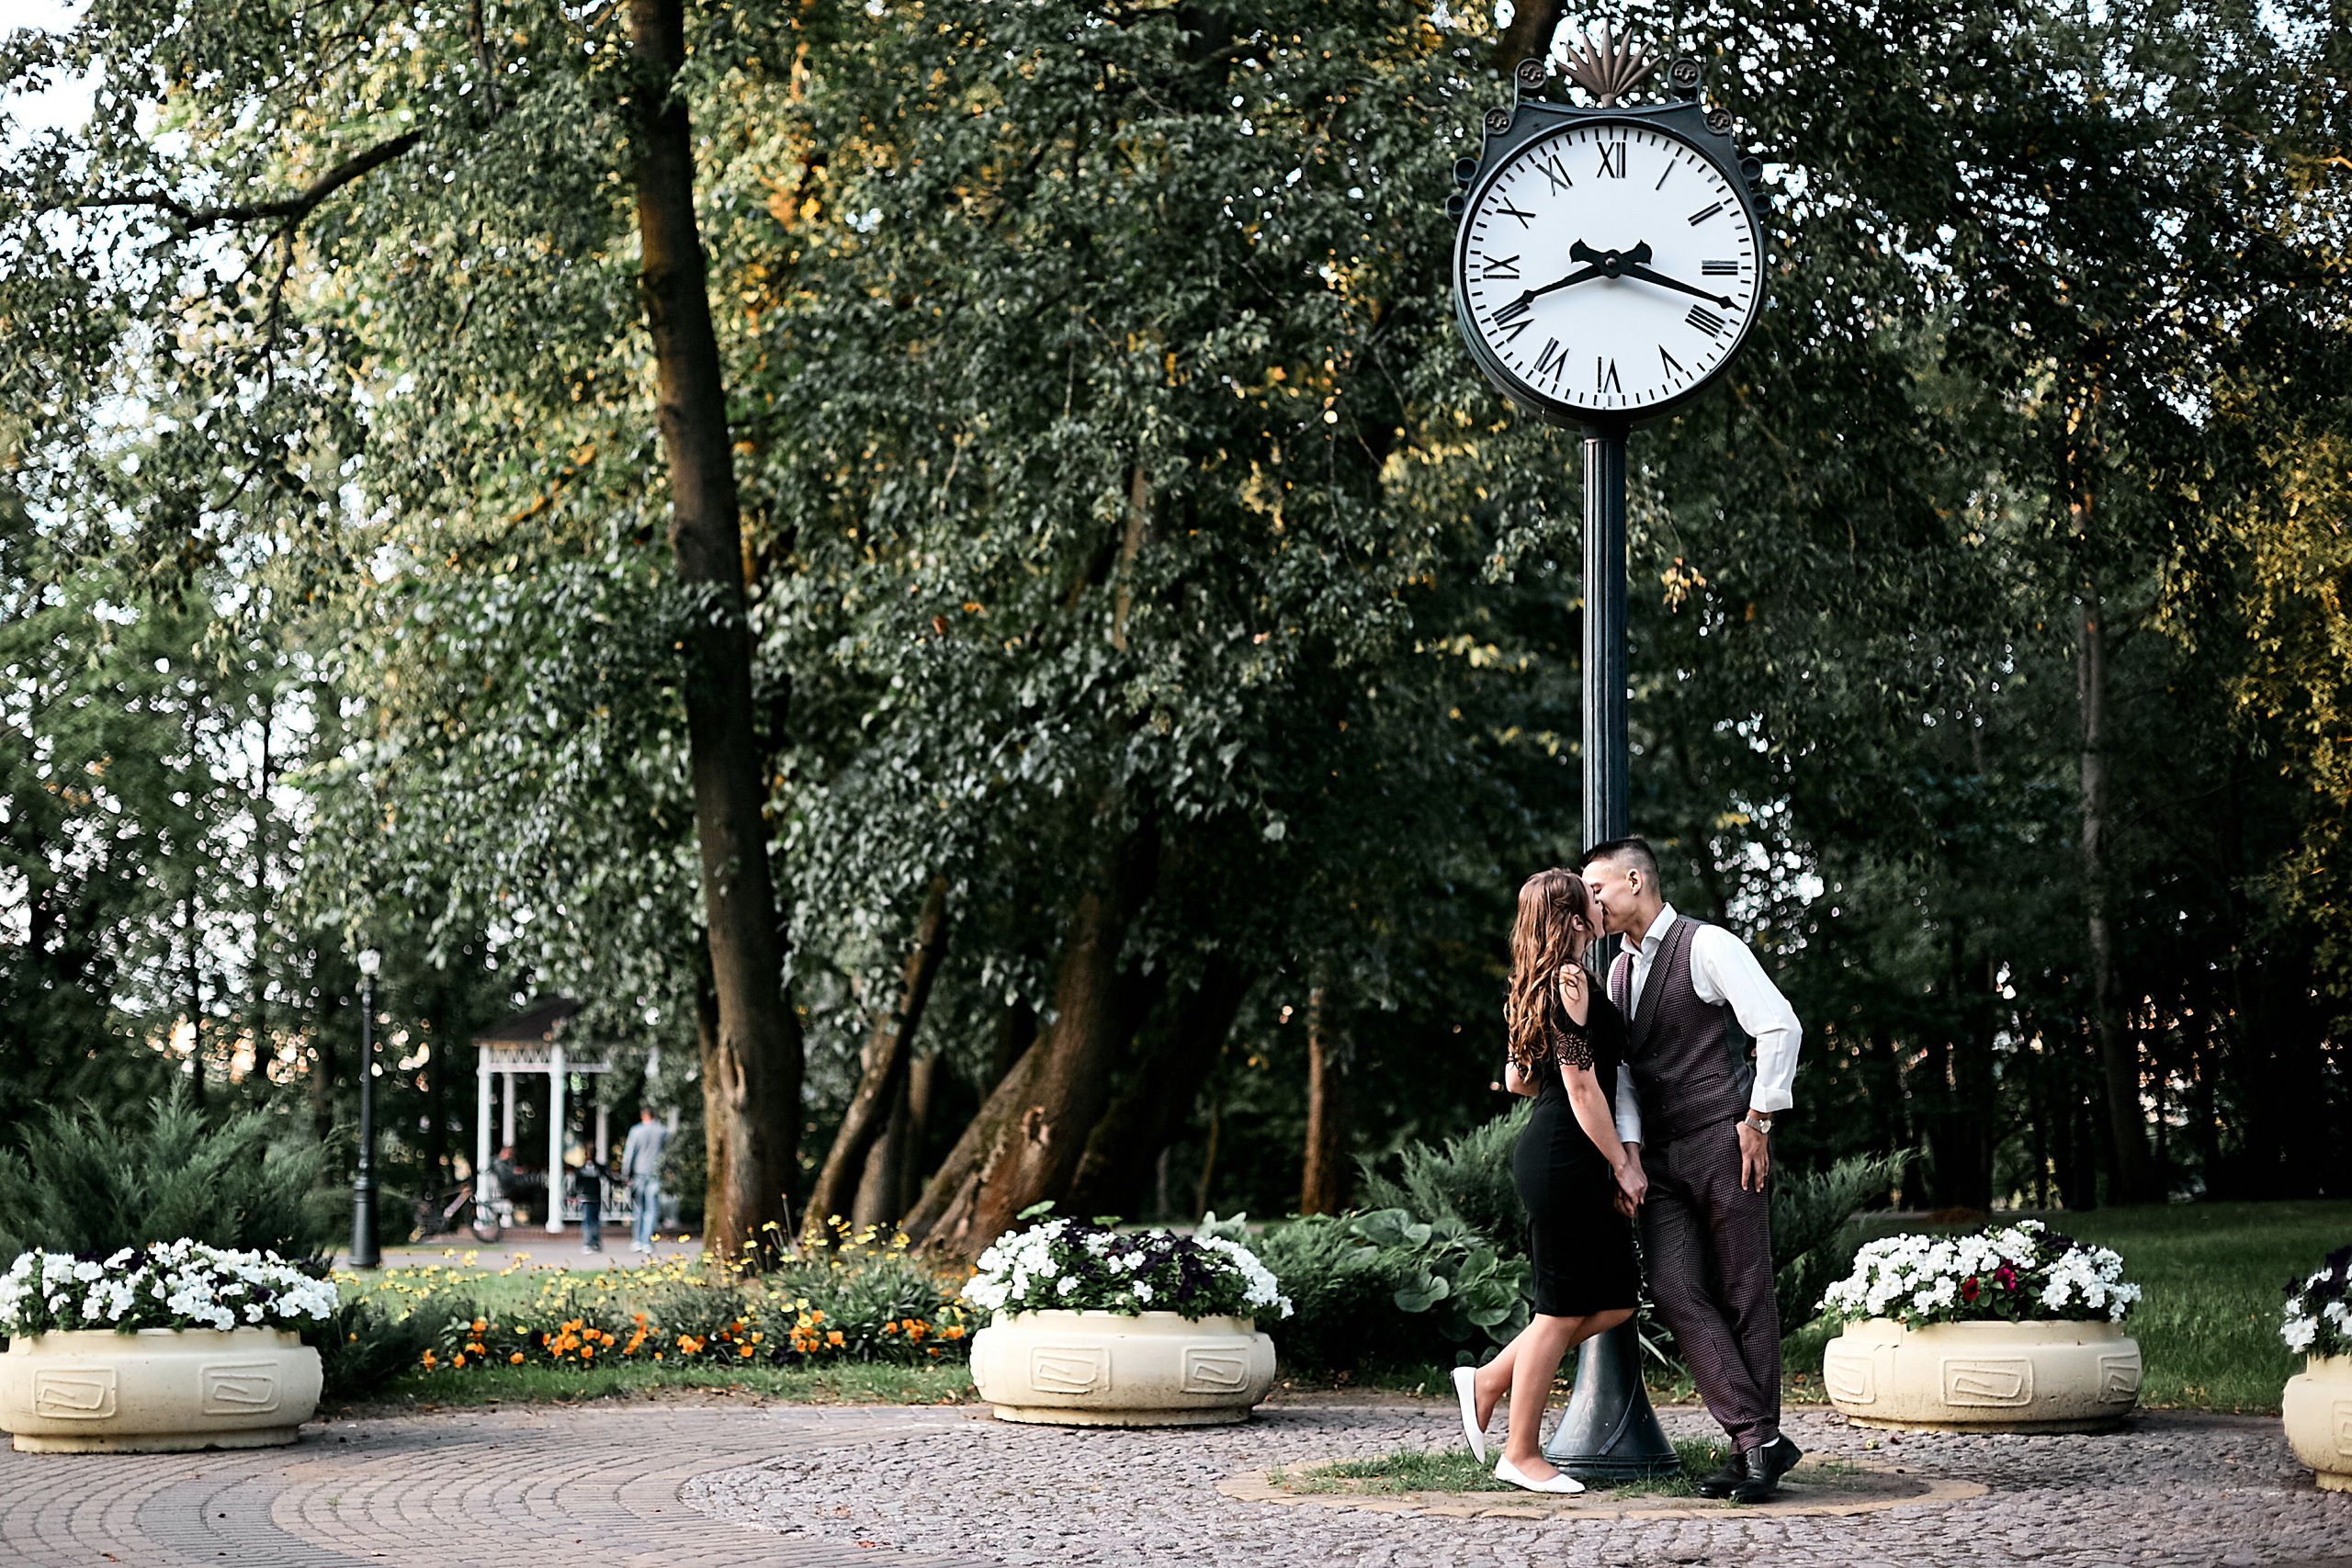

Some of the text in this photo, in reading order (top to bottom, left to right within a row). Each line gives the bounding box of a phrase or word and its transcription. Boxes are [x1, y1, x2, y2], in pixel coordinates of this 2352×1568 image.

[1535, 154, 1573, 196] XI
[1597, 141, 1626, 178] XII
[1656, 159, 1677, 191] I
[1496, 196, 1536, 229] X
[1688, 201, 1724, 226] II
[1483, 254, 1520, 279] IX
[1702, 260, 1738, 276] III
[1685, 304, 1725, 339] IIII
[1534, 337, 1569, 382] VII
[1598, 356, 1622, 393] VI
[1658, 344, 1683, 379] V
